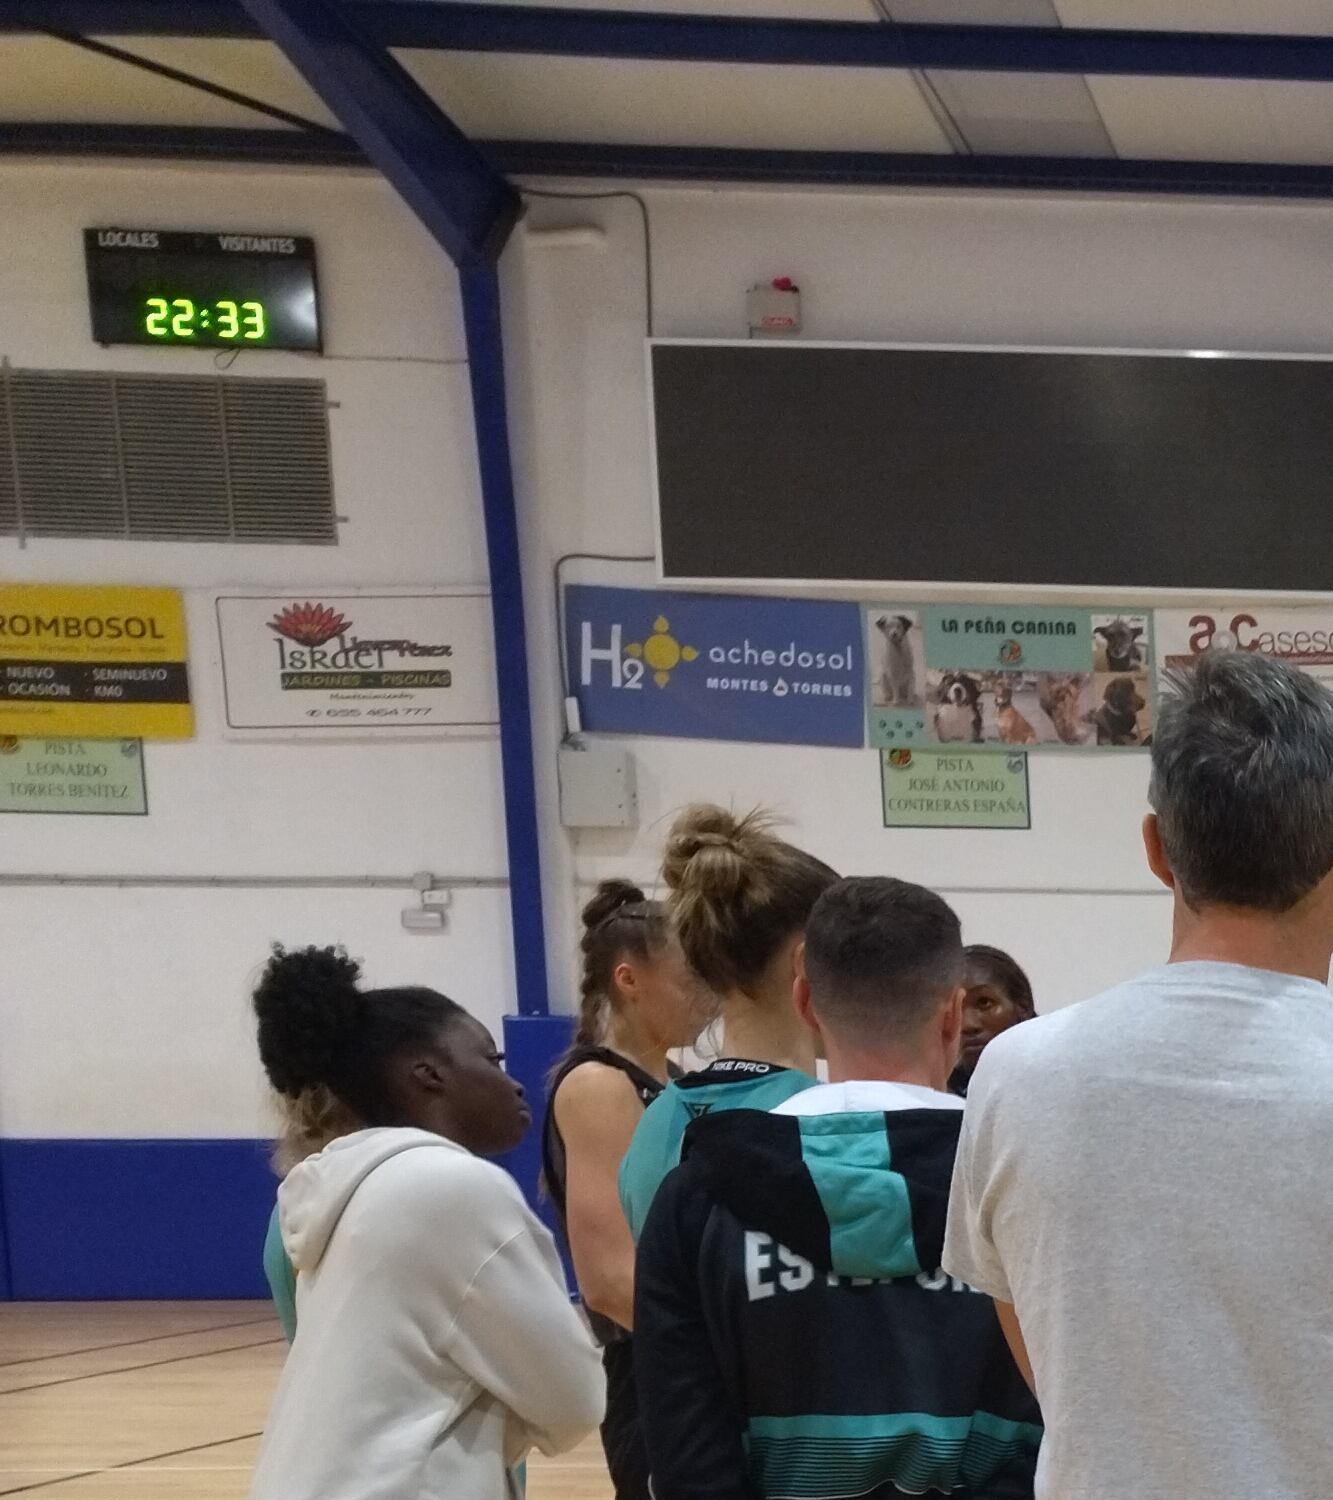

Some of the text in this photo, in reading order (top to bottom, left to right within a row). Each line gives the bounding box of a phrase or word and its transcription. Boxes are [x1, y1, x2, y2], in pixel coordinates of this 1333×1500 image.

[98, 231, 297, 254] LOCALES VISITANTES
[145, 297, 266, 340] 22:33
[941, 615, 1077, 636] LA PEÑA CANINA
[709, 639, 853, 671] achedosol
[6, 666, 55, 680] NUEVO
[92, 668, 168, 681] SEMINUEVO
[7, 682, 71, 697] OCASIÓN
[706, 677, 853, 697] MONTES TORRES
[26, 761, 108, 778] LEONARDO
[935, 758, 975, 773] PISTA
[8, 781, 65, 797] TORRES
[907, 776, 1006, 793] JOSÉ ANTONIO
[887, 798, 1026, 815] CONTRERAS ESPAÑA
[733, 1061, 770, 1073] PRO
